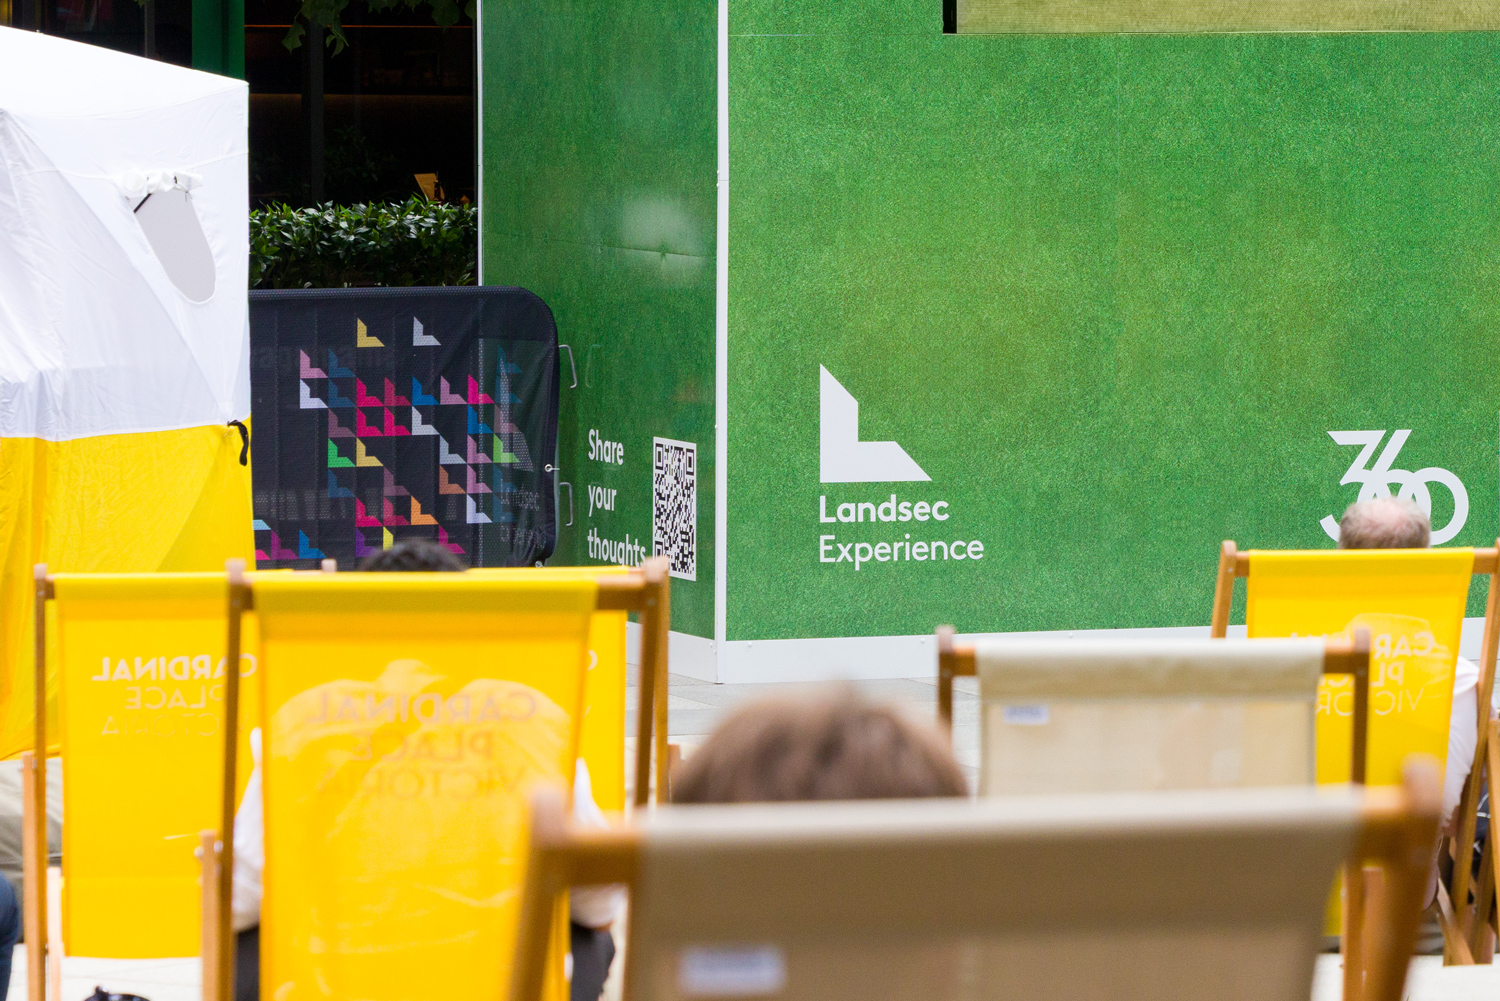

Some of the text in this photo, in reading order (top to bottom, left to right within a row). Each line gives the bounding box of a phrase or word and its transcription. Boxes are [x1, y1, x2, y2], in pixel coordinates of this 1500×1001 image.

[588, 428, 625, 466] Share
[588, 484, 618, 518] your
[819, 493, 950, 523] Landsec
[587, 527, 647, 568] thoughts
[819, 533, 985, 571] Experience
